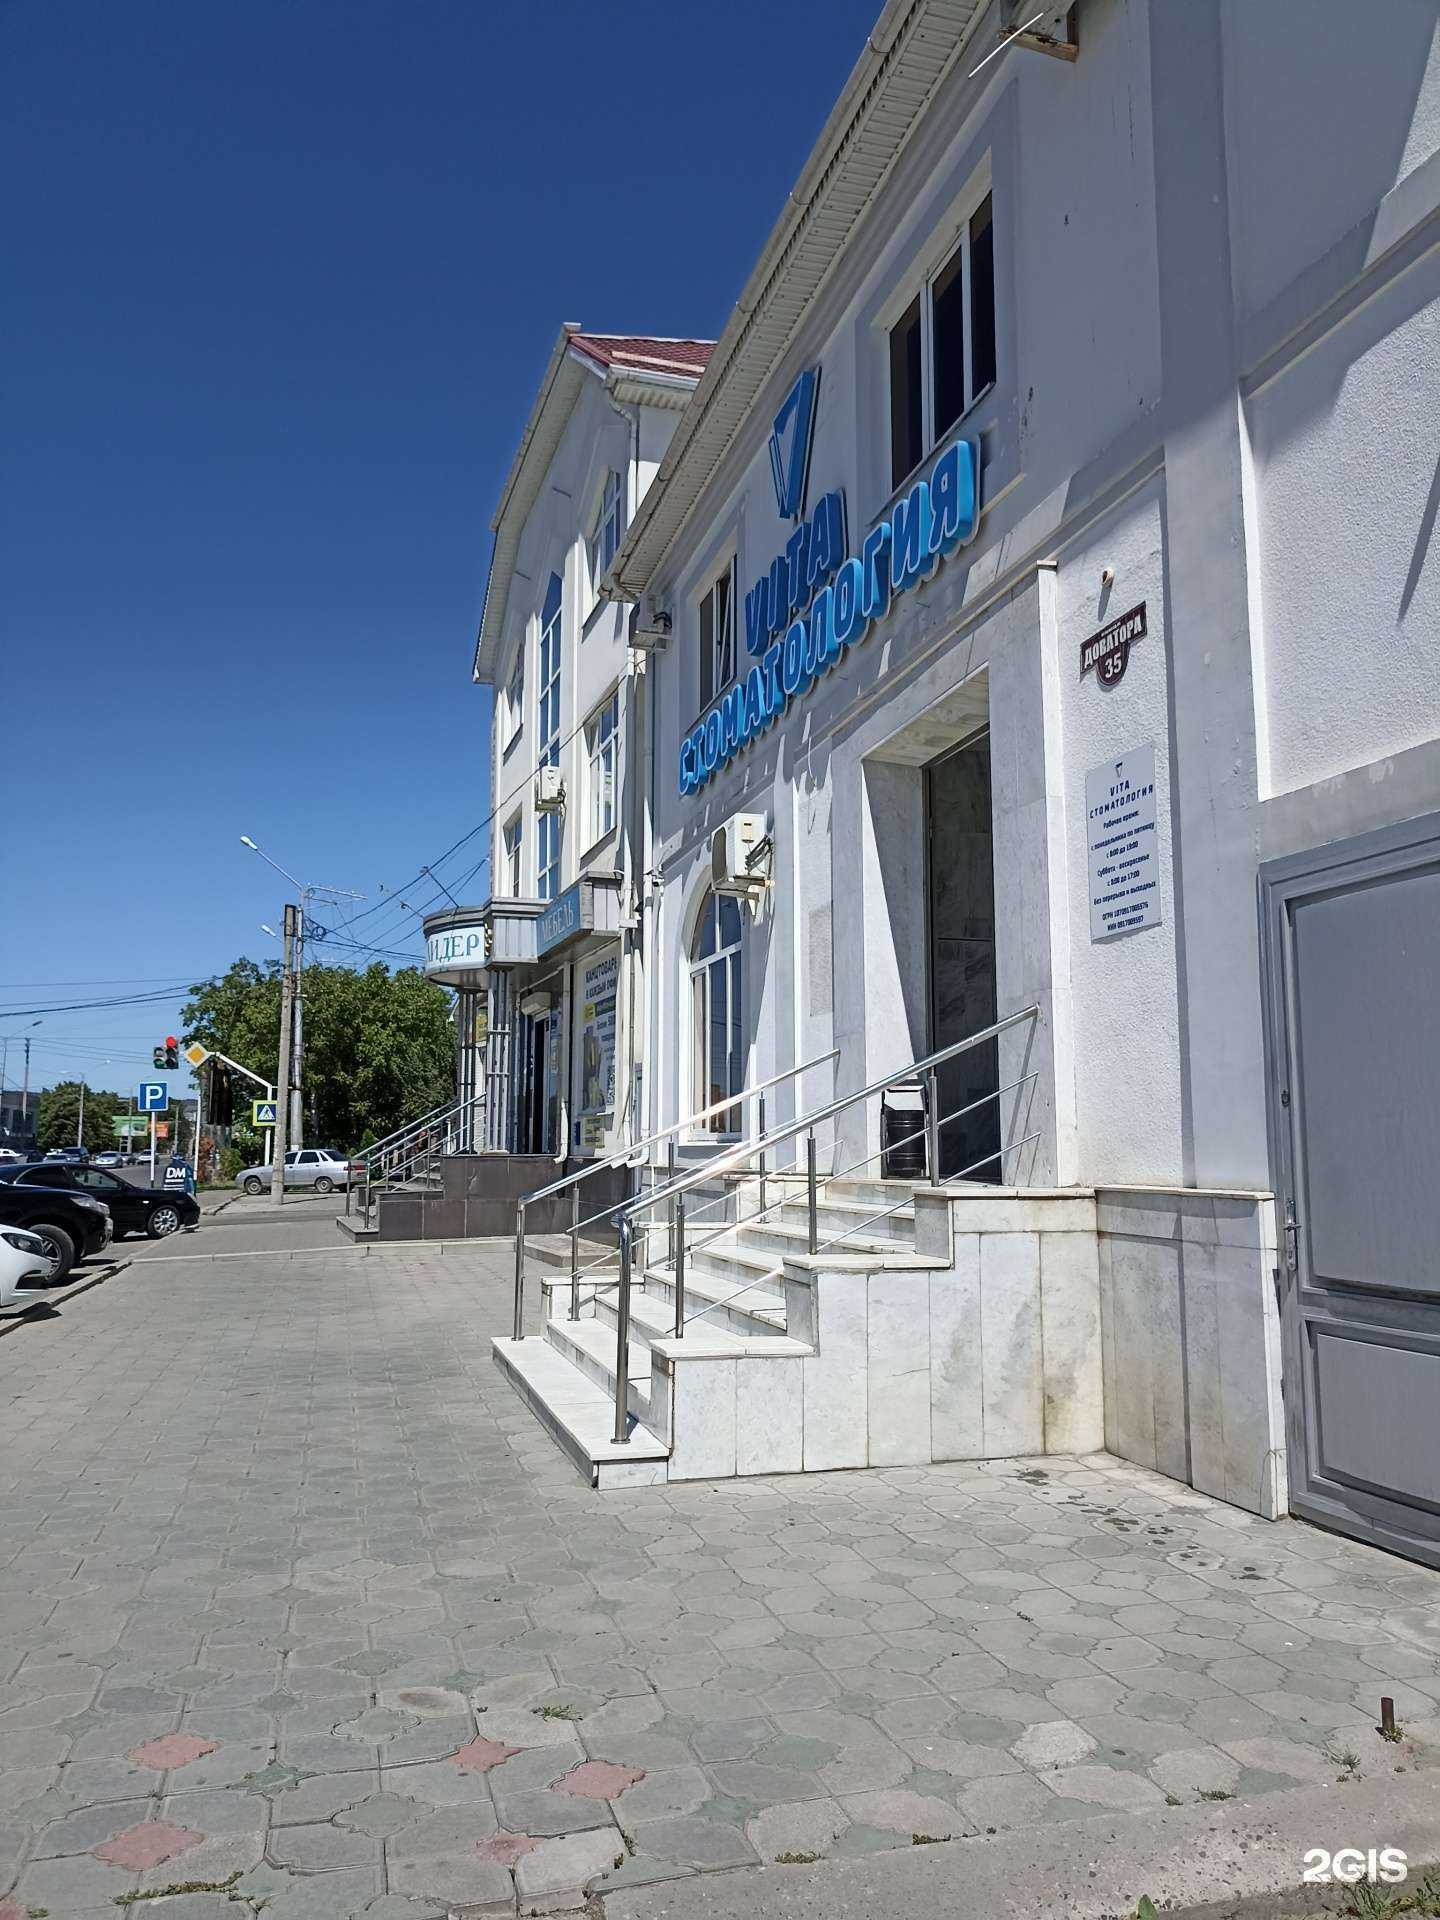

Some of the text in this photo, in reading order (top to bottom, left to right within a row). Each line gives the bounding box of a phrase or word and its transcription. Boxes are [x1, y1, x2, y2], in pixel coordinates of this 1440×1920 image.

[745, 491, 845, 656] VITA
[679, 440, 976, 796] СТОМАТОЛОГИЯ
[1084, 614, 1142, 668] ДОВАТОРА
[1105, 652, 1122, 679] 35
[1110, 780, 1130, 797] VITA
[1089, 784, 1154, 819] СТОМАТОЛОГИЯ
[1103, 817, 1122, 829] Рабочее
[1094, 832, 1127, 850] понедельника
[1134, 822, 1155, 835] пятницу
[1097, 865, 1116, 878] Суббота
[1119, 854, 1150, 870] воскресенье
[1127, 870, 1140, 880] 17:00
[1130, 881, 1156, 894] выходных
[542, 901, 574, 942] МЕБЕЛЬ
[145, 1085, 163, 1109] P
[166, 1167, 186, 1178] DM
